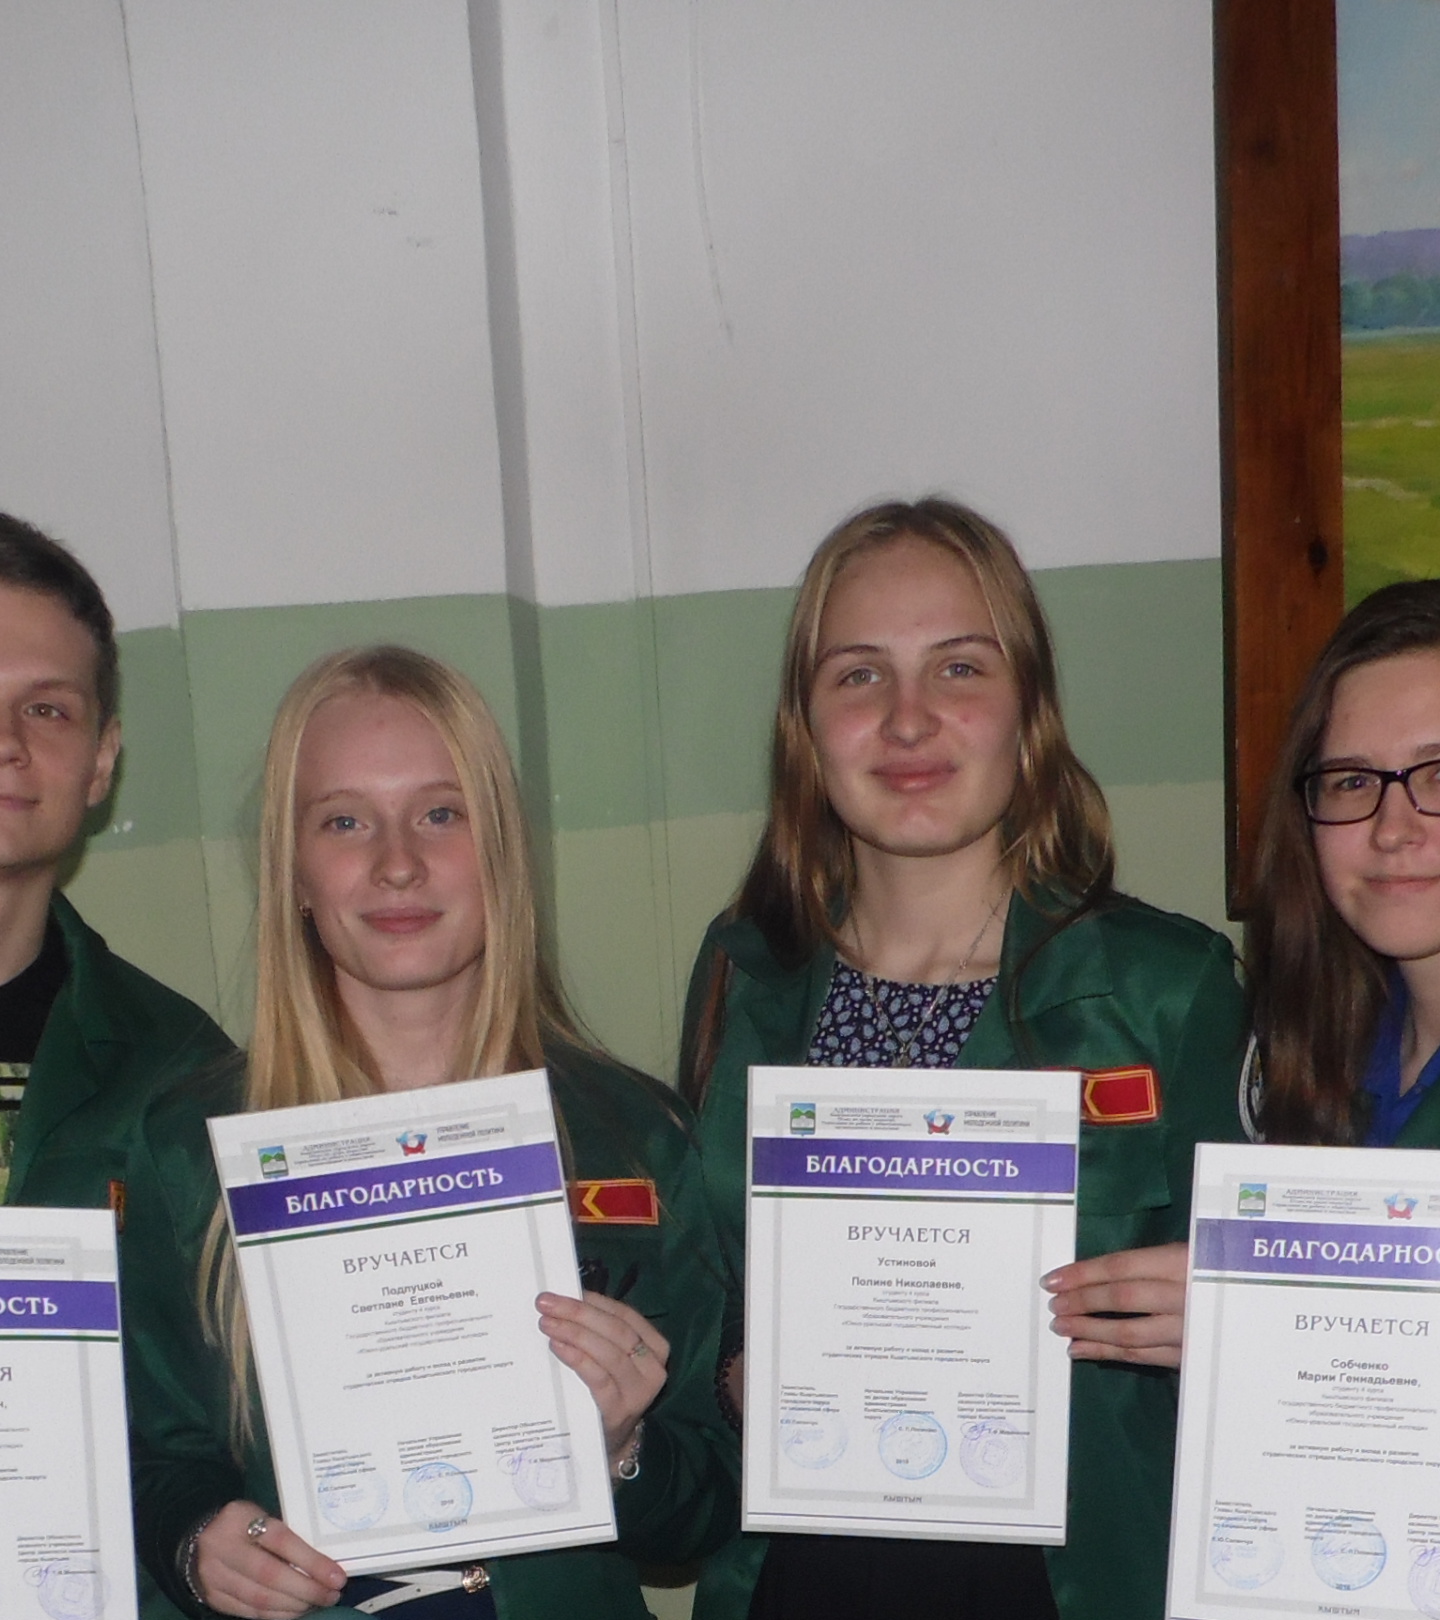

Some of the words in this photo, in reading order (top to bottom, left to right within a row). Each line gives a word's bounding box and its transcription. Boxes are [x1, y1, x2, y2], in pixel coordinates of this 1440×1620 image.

[805, 1155, 1020, 1178] БЛАГОДАРНОСТЬ
[285, 1167, 504, 1214] БЛАГОДАРНОСТЬ
[847, 1225, 971, 1244] ВРУЧАЕТСЯ
[342, 1242, 469, 1274] ВРУЧАЕТСЯ
[877, 1257, 936, 1268] Устиновой
[381, 1278, 443, 1297] Подлуцкой
[851, 1276, 893, 1287] Полине
[896, 1278, 965, 1291] Николаевне,
[351, 1299, 404, 1314] Светлане
[1294, 1314, 1430, 1337] ВРУЧАЕТСЯ
[1330, 1358, 1389, 1371] Собченко
[1297, 1370, 1336, 1383] Марии
[1339, 1373, 1421, 1387] Геннадьевне,
